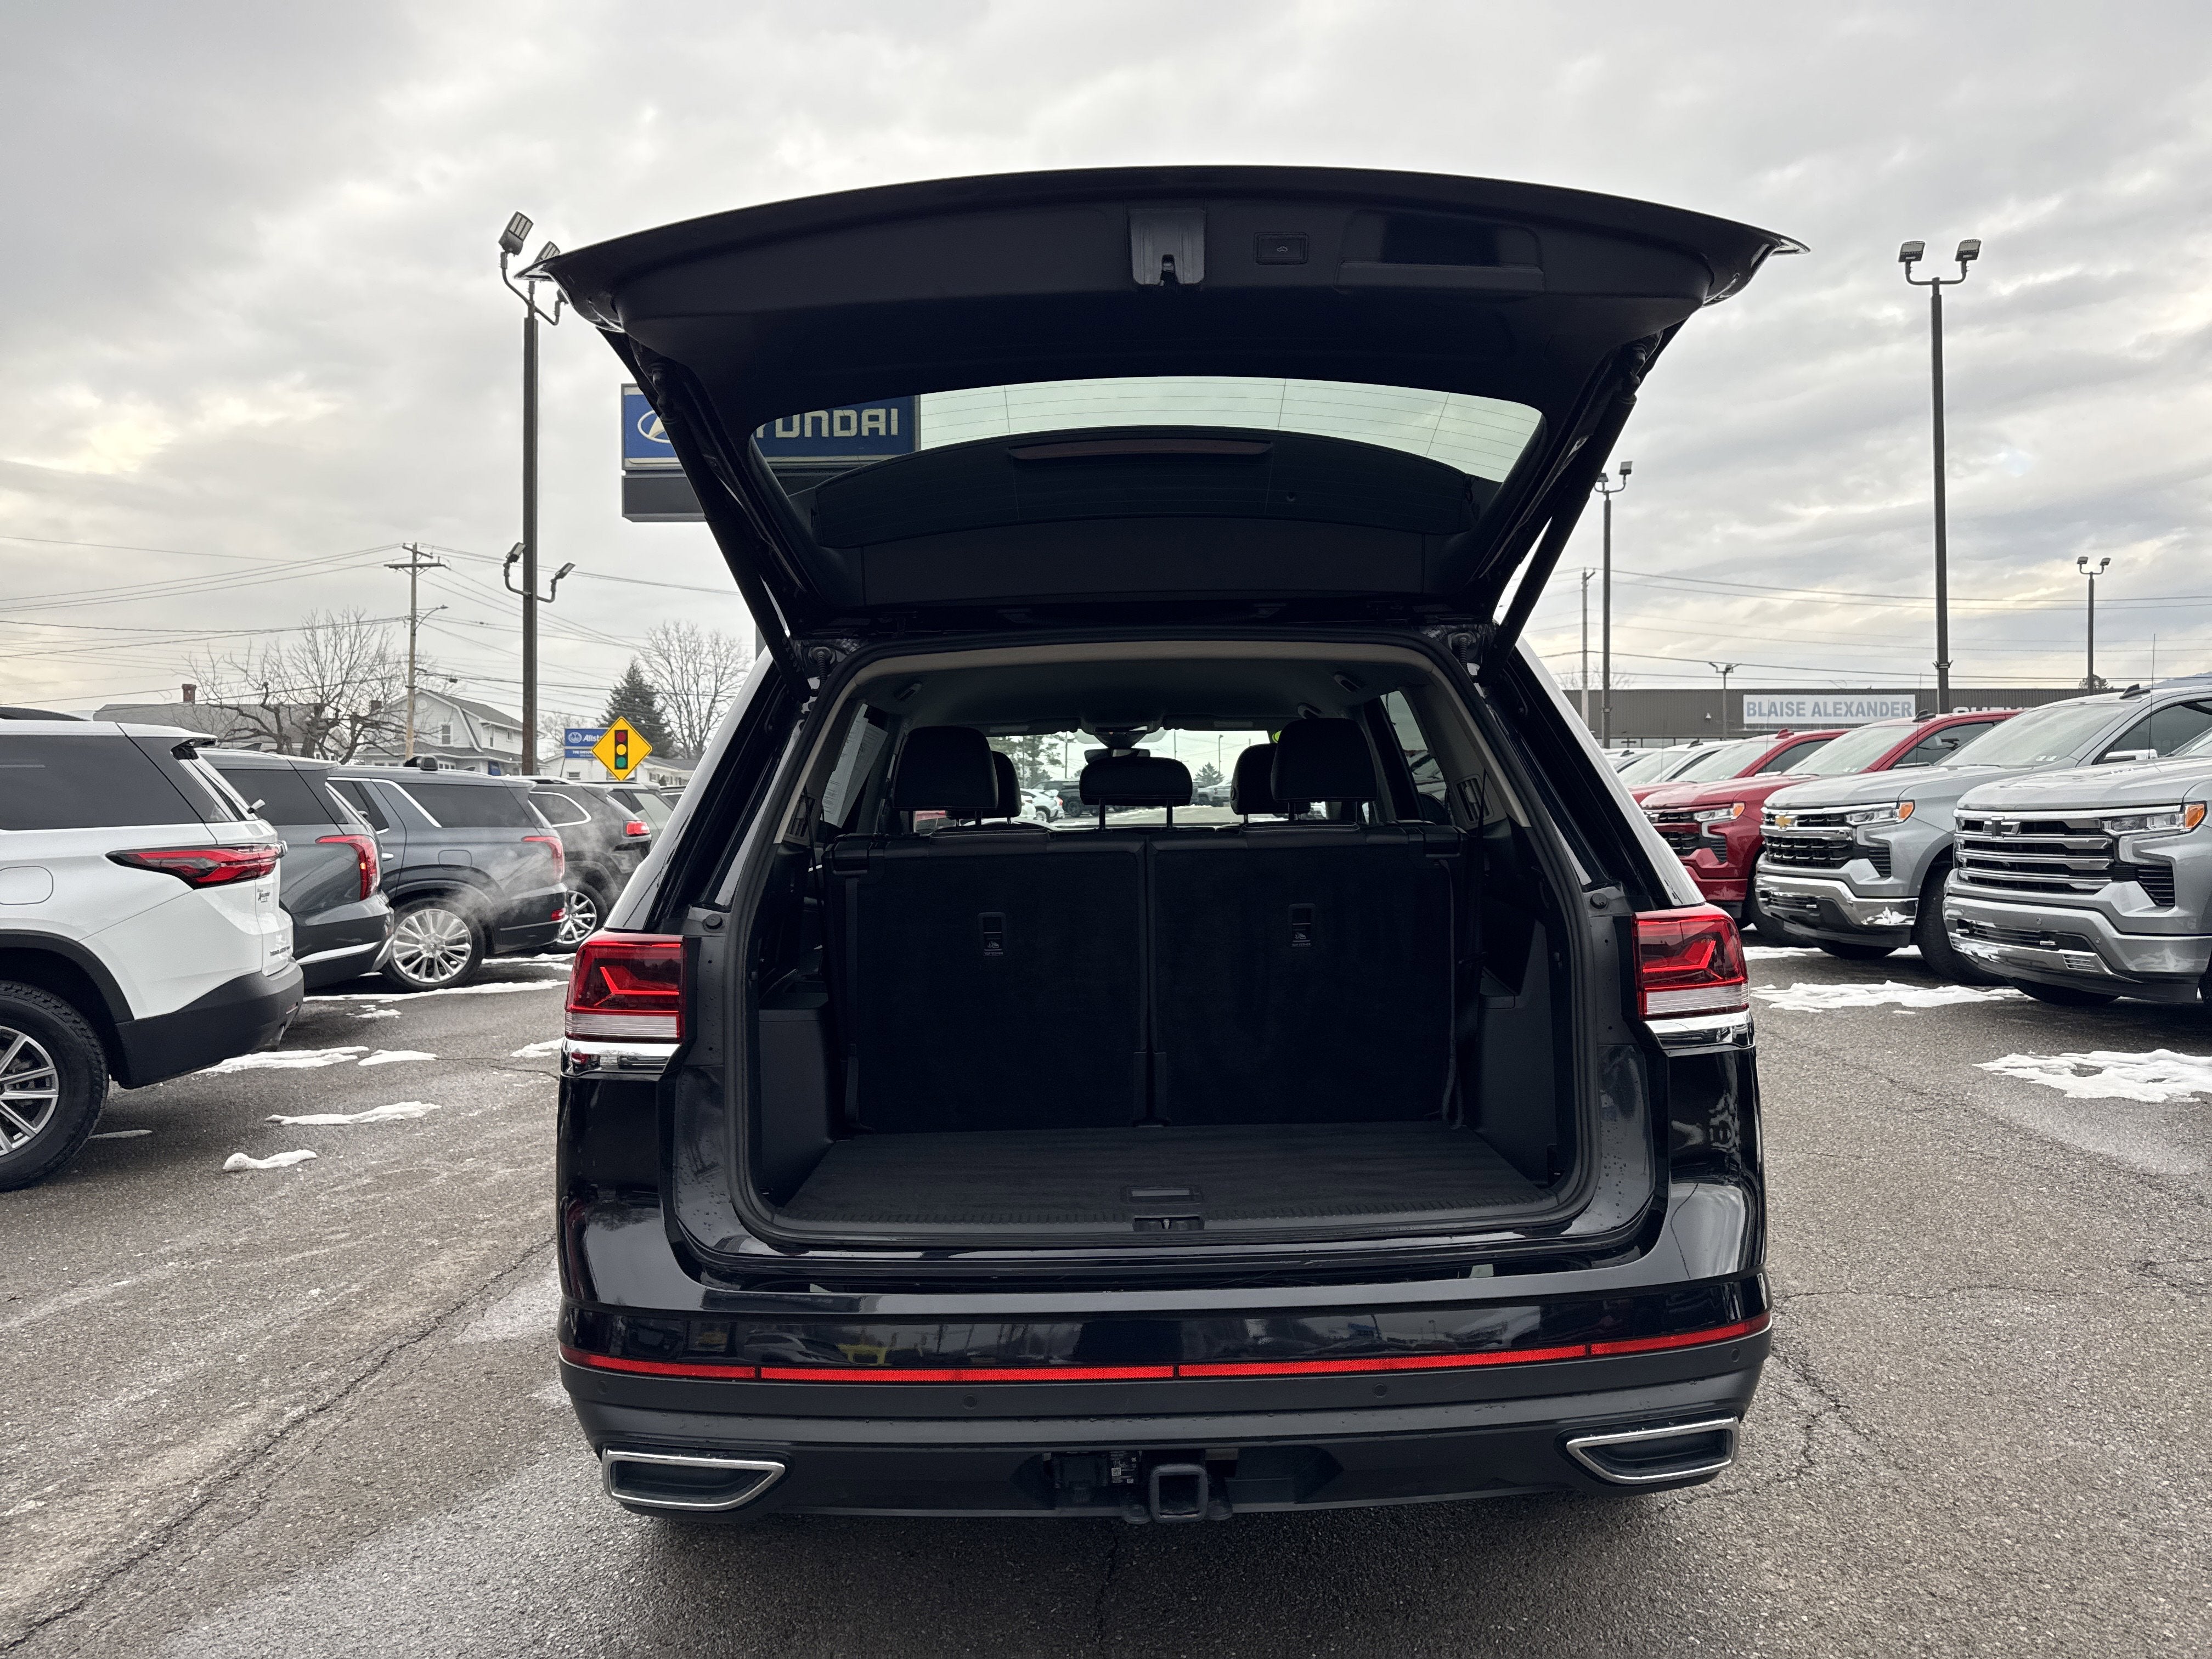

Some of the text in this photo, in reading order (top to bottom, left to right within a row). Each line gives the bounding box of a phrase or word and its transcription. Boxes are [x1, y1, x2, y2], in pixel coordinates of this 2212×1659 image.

[757, 408, 898, 438] UNDAI
[1746, 701, 1912, 717] BLAISE ALEXANDER
[582, 734, 602, 742] Allst
